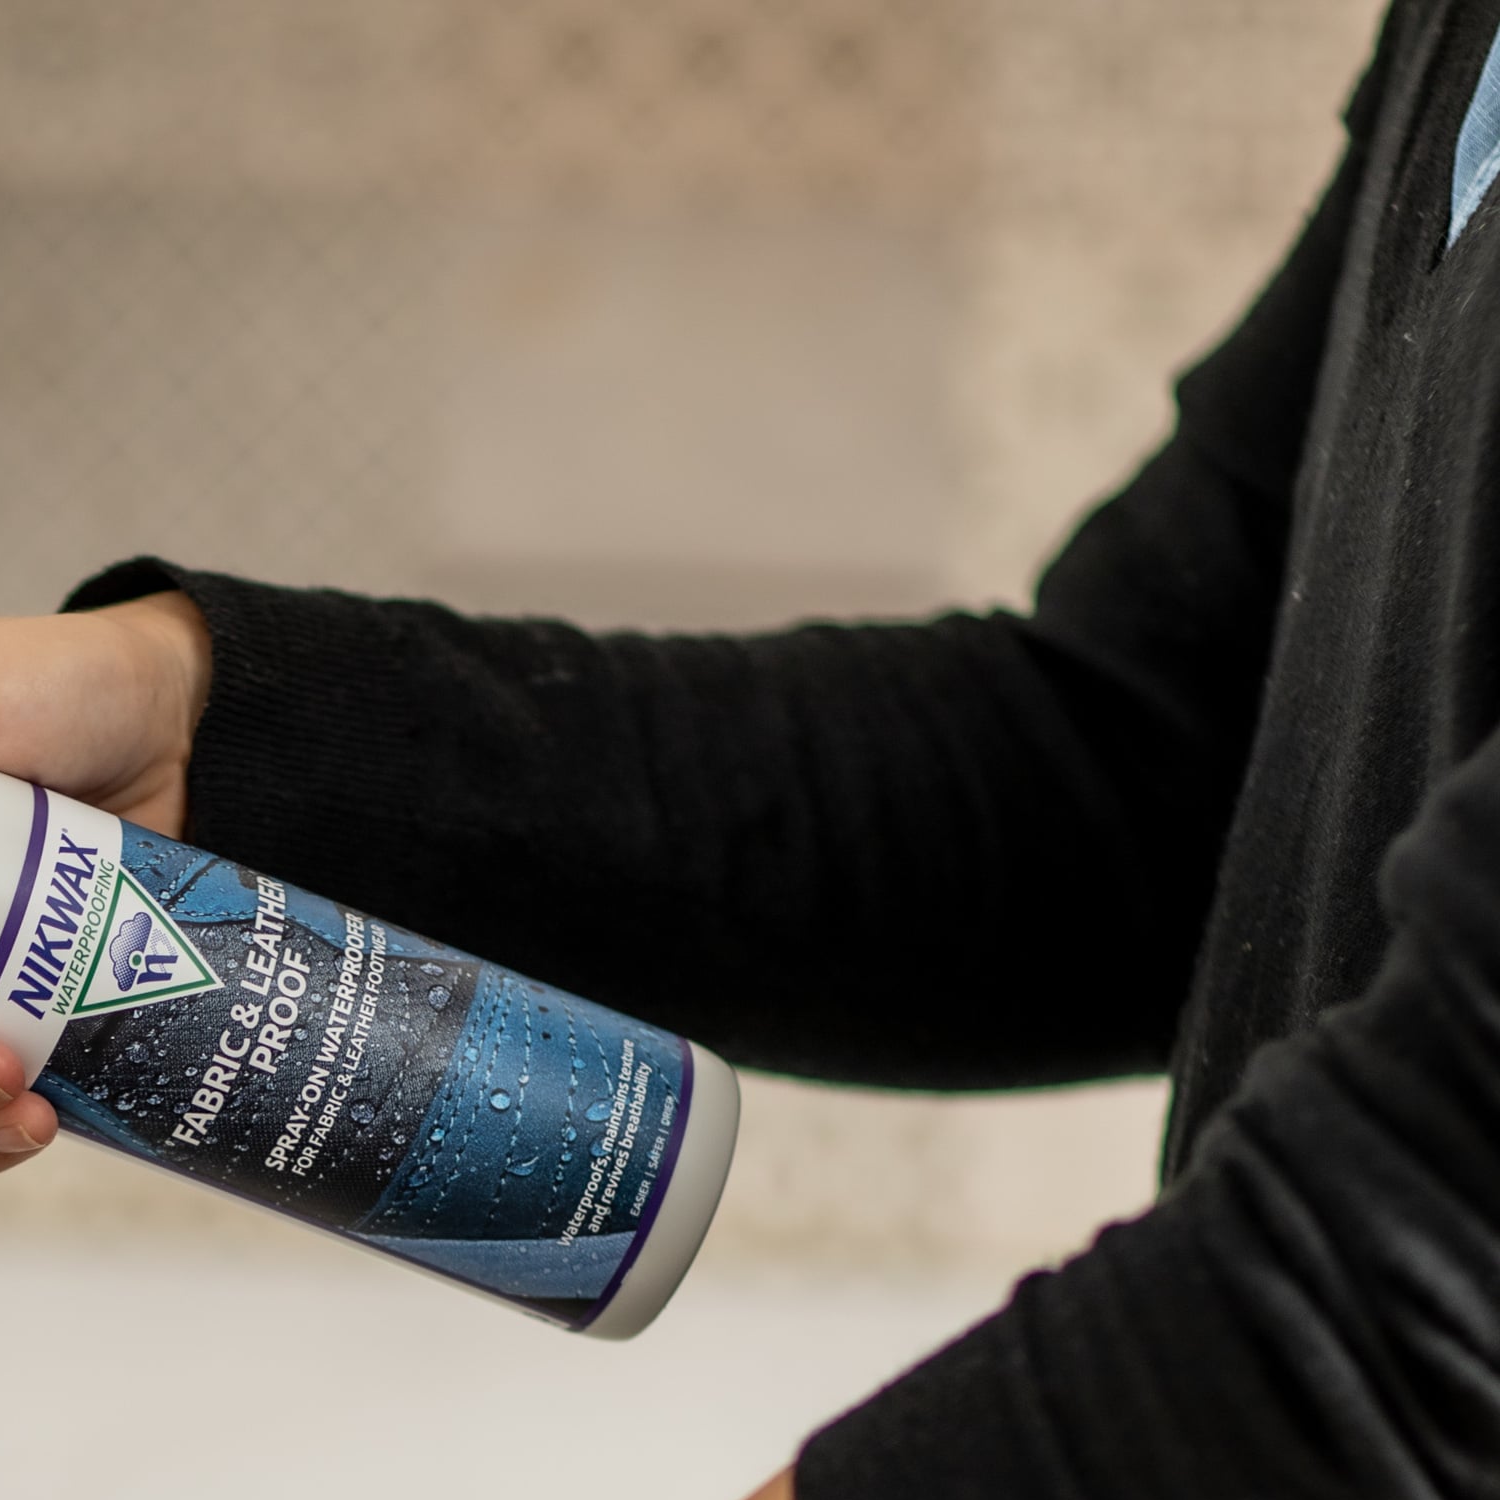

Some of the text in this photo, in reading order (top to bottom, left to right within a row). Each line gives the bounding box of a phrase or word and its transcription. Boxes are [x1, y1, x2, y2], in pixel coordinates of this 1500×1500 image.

[8, 833, 98, 1020] NIKWAX
[52, 858, 115, 1016] WATERPROOFING
[172, 875, 285, 1146] FABRIC & LEATHER
[249, 947, 311, 1075] PROOF
[265, 912, 365, 1171] SPRAY-ON WATERPROOFER
[292, 924, 387, 1176] FOR FABRIC & LEATHER FOOTWEAR
[557, 1038, 635, 1247] Waterproofs, maintains texture
[588, 1061, 653, 1233] and revives breathability
[629, 1180, 652, 1217] EASIER
[648, 1136, 666, 1169] SAFER
